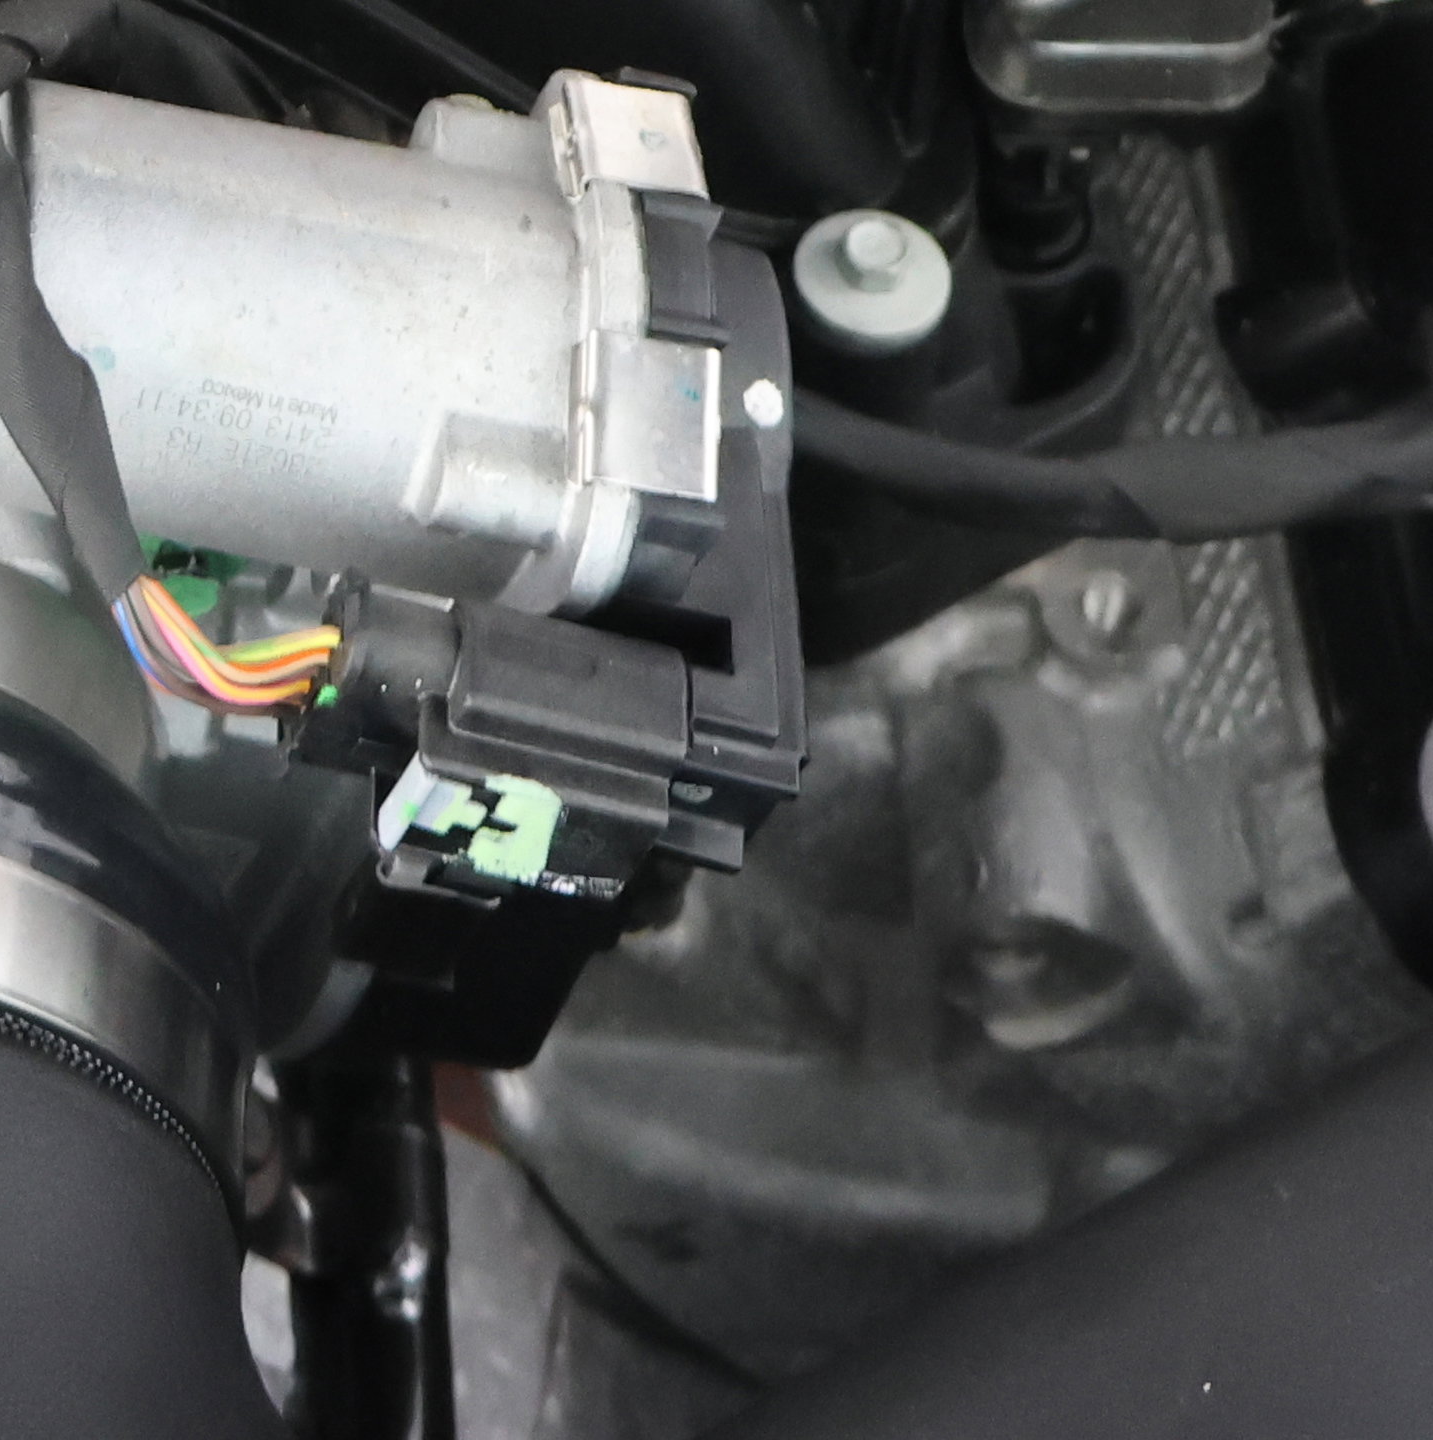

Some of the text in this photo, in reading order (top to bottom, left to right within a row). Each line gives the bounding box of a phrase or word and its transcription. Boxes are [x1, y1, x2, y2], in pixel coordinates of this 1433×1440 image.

[201, 378, 338, 425] Made in Mexico
